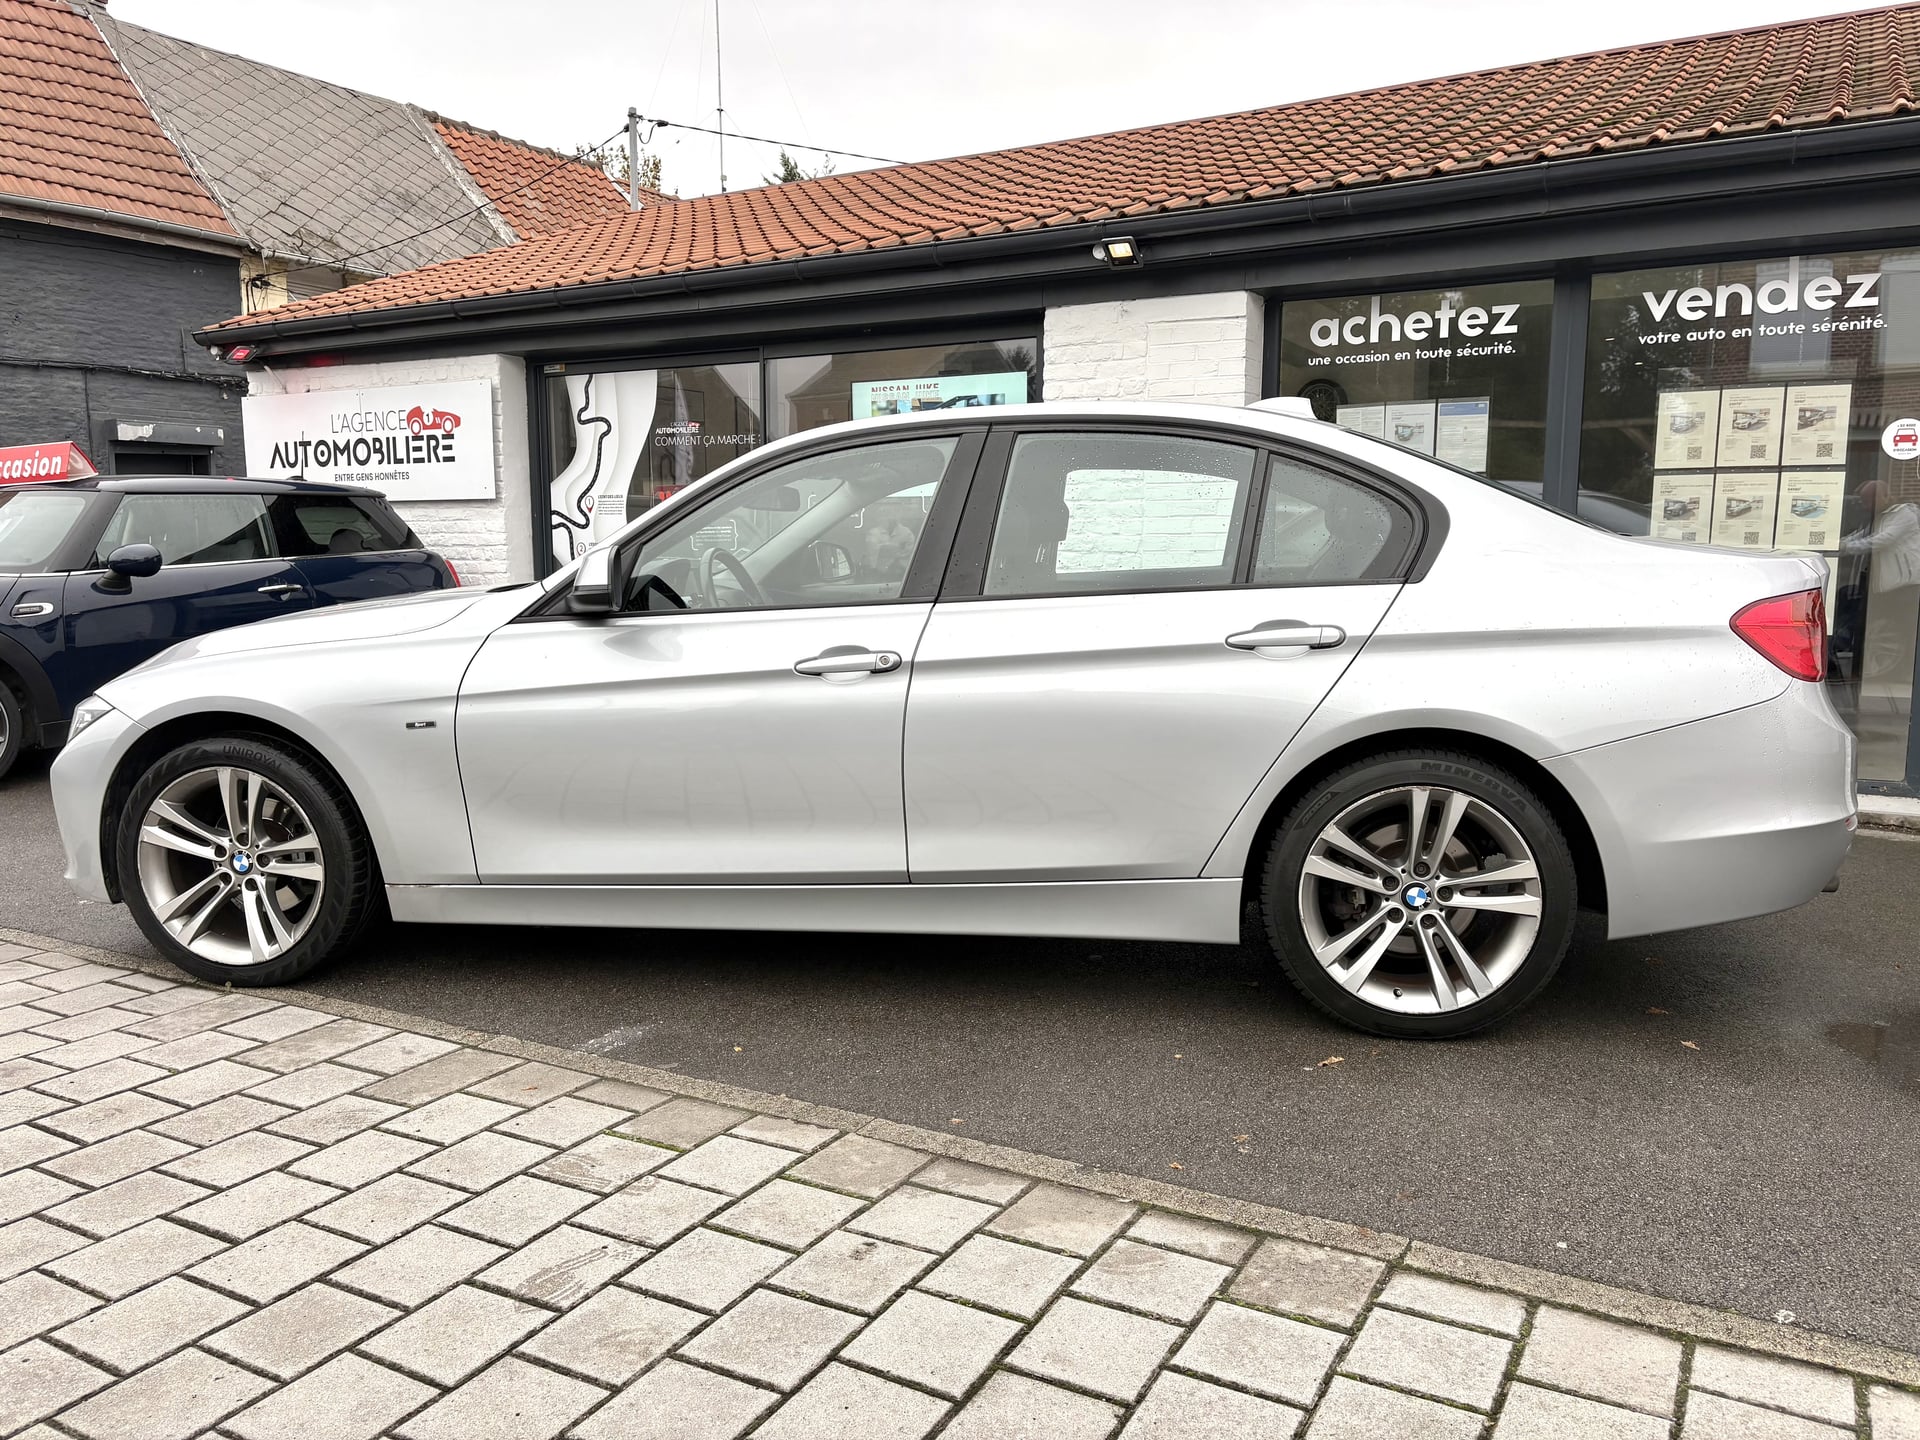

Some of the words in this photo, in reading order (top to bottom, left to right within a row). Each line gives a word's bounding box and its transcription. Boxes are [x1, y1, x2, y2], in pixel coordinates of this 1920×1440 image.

[1642, 256, 1882, 322] vendez
[1309, 295, 1520, 348] achetez
[1638, 332, 1681, 345] votre
[1686, 328, 1726, 343] auto
[1731, 328, 1752, 338] en
[1759, 322, 1806, 337] toute
[1811, 313, 1888, 334] sérénité.
[1308, 356, 1331, 366] une
[1335, 350, 1390, 365] occasion
[1394, 351, 1411, 361] en
[1415, 348, 1452, 360] toute
[1456, 340, 1516, 358] sécurité.
[331, 410, 407, 434] L'AGENCE
[654, 435, 701, 446] COMMENT
[703, 435, 716, 448] ÇA
[717, 433, 756, 445] MARCHE
[0, 450, 62, 479] casion
[334, 472, 355, 482] ENTRE
[355, 472, 374, 481] GENS
[374, 470, 410, 480] HONNÊTES
[1420, 762, 1528, 813] MINERVA
